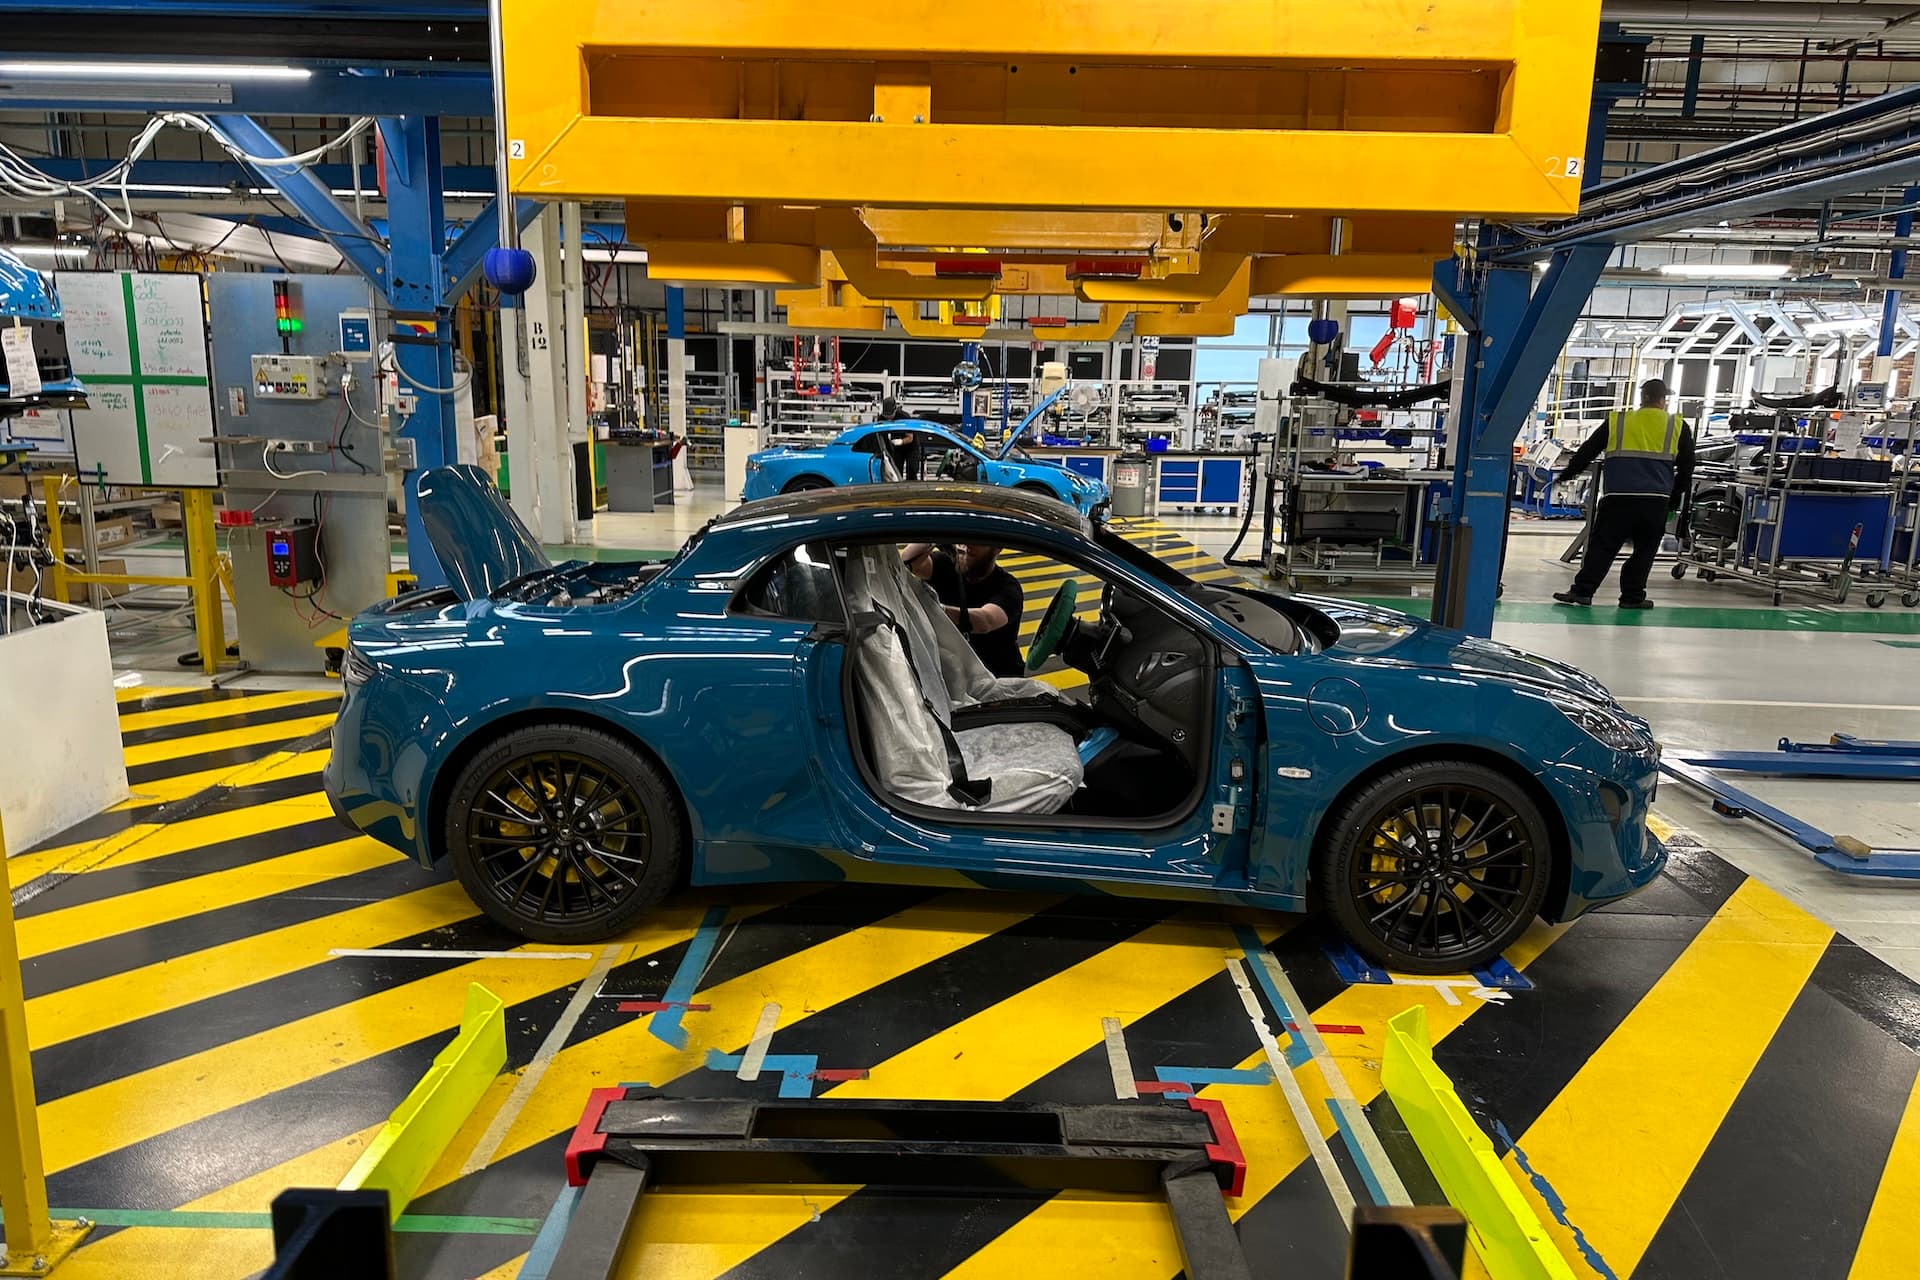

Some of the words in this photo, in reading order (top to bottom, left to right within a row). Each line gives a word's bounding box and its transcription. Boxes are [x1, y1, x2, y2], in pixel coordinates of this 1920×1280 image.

[512, 142, 522, 157] 2
[1568, 160, 1579, 175] 2
[533, 322, 543, 335] B
[532, 337, 547, 350] 12
